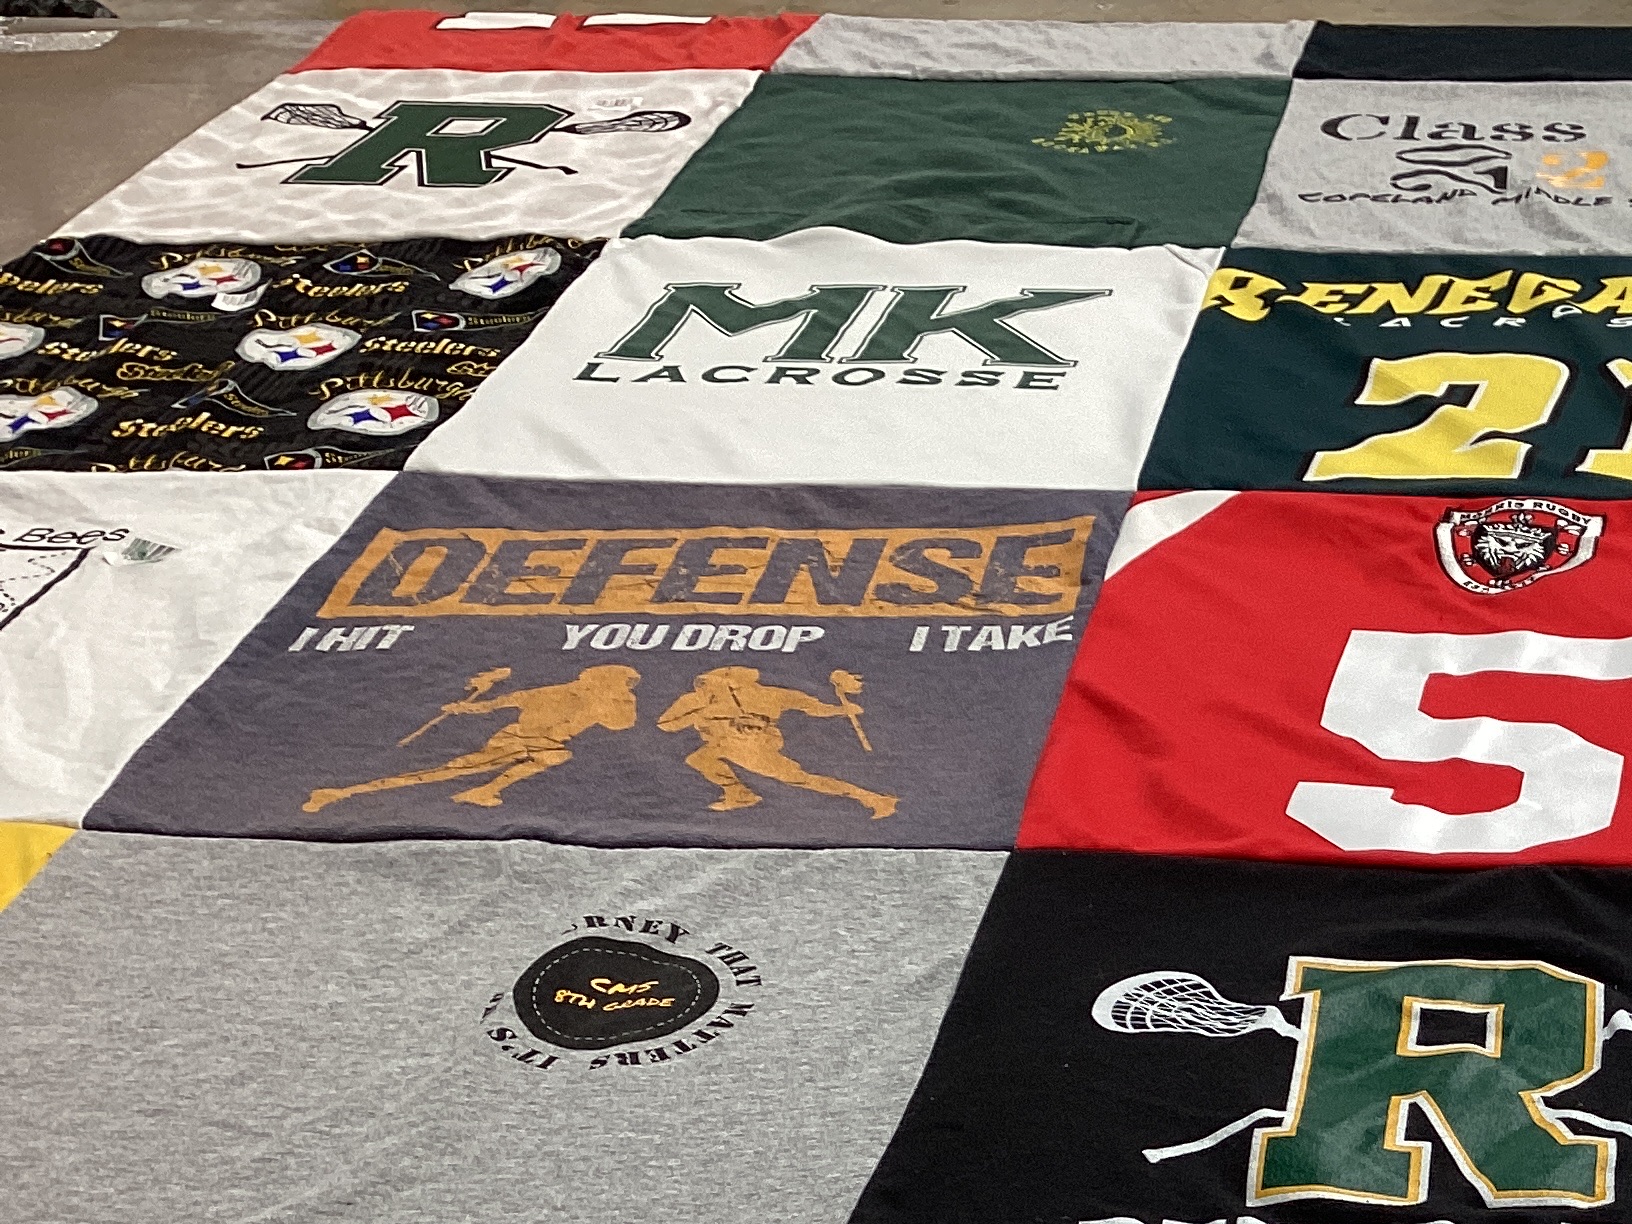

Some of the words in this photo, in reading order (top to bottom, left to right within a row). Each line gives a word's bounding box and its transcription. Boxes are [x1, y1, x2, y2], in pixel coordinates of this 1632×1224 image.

[1319, 113, 1588, 142] Class
[280, 100, 574, 187] R
[1297, 187, 1478, 206] COPELAND
[594, 282, 1114, 368] MK
[360, 336, 501, 358] Steelers
[572, 362, 1068, 391] LACROSSE
[111, 411, 265, 439] Steelers
[1532, 501, 1592, 526] RUGBY
[13, 527, 130, 545] Bees
[360, 535, 1084, 608] DEFENSE
[288, 627, 313, 651] I
[315, 624, 417, 651] HIT
[560, 623, 688, 652] YOU
[689, 625, 827, 653] DROP
[909, 626, 932, 652] I
[938, 616, 1076, 652] TAKE
[562, 914, 691, 944] RNEY
[704, 942, 763, 987] THAT
[590, 977, 660, 996] CMS
[601, 995, 677, 1013] GRADE
[589, 1002, 756, 1071] MATTERS
[1247, 954, 1618, 1209] R
